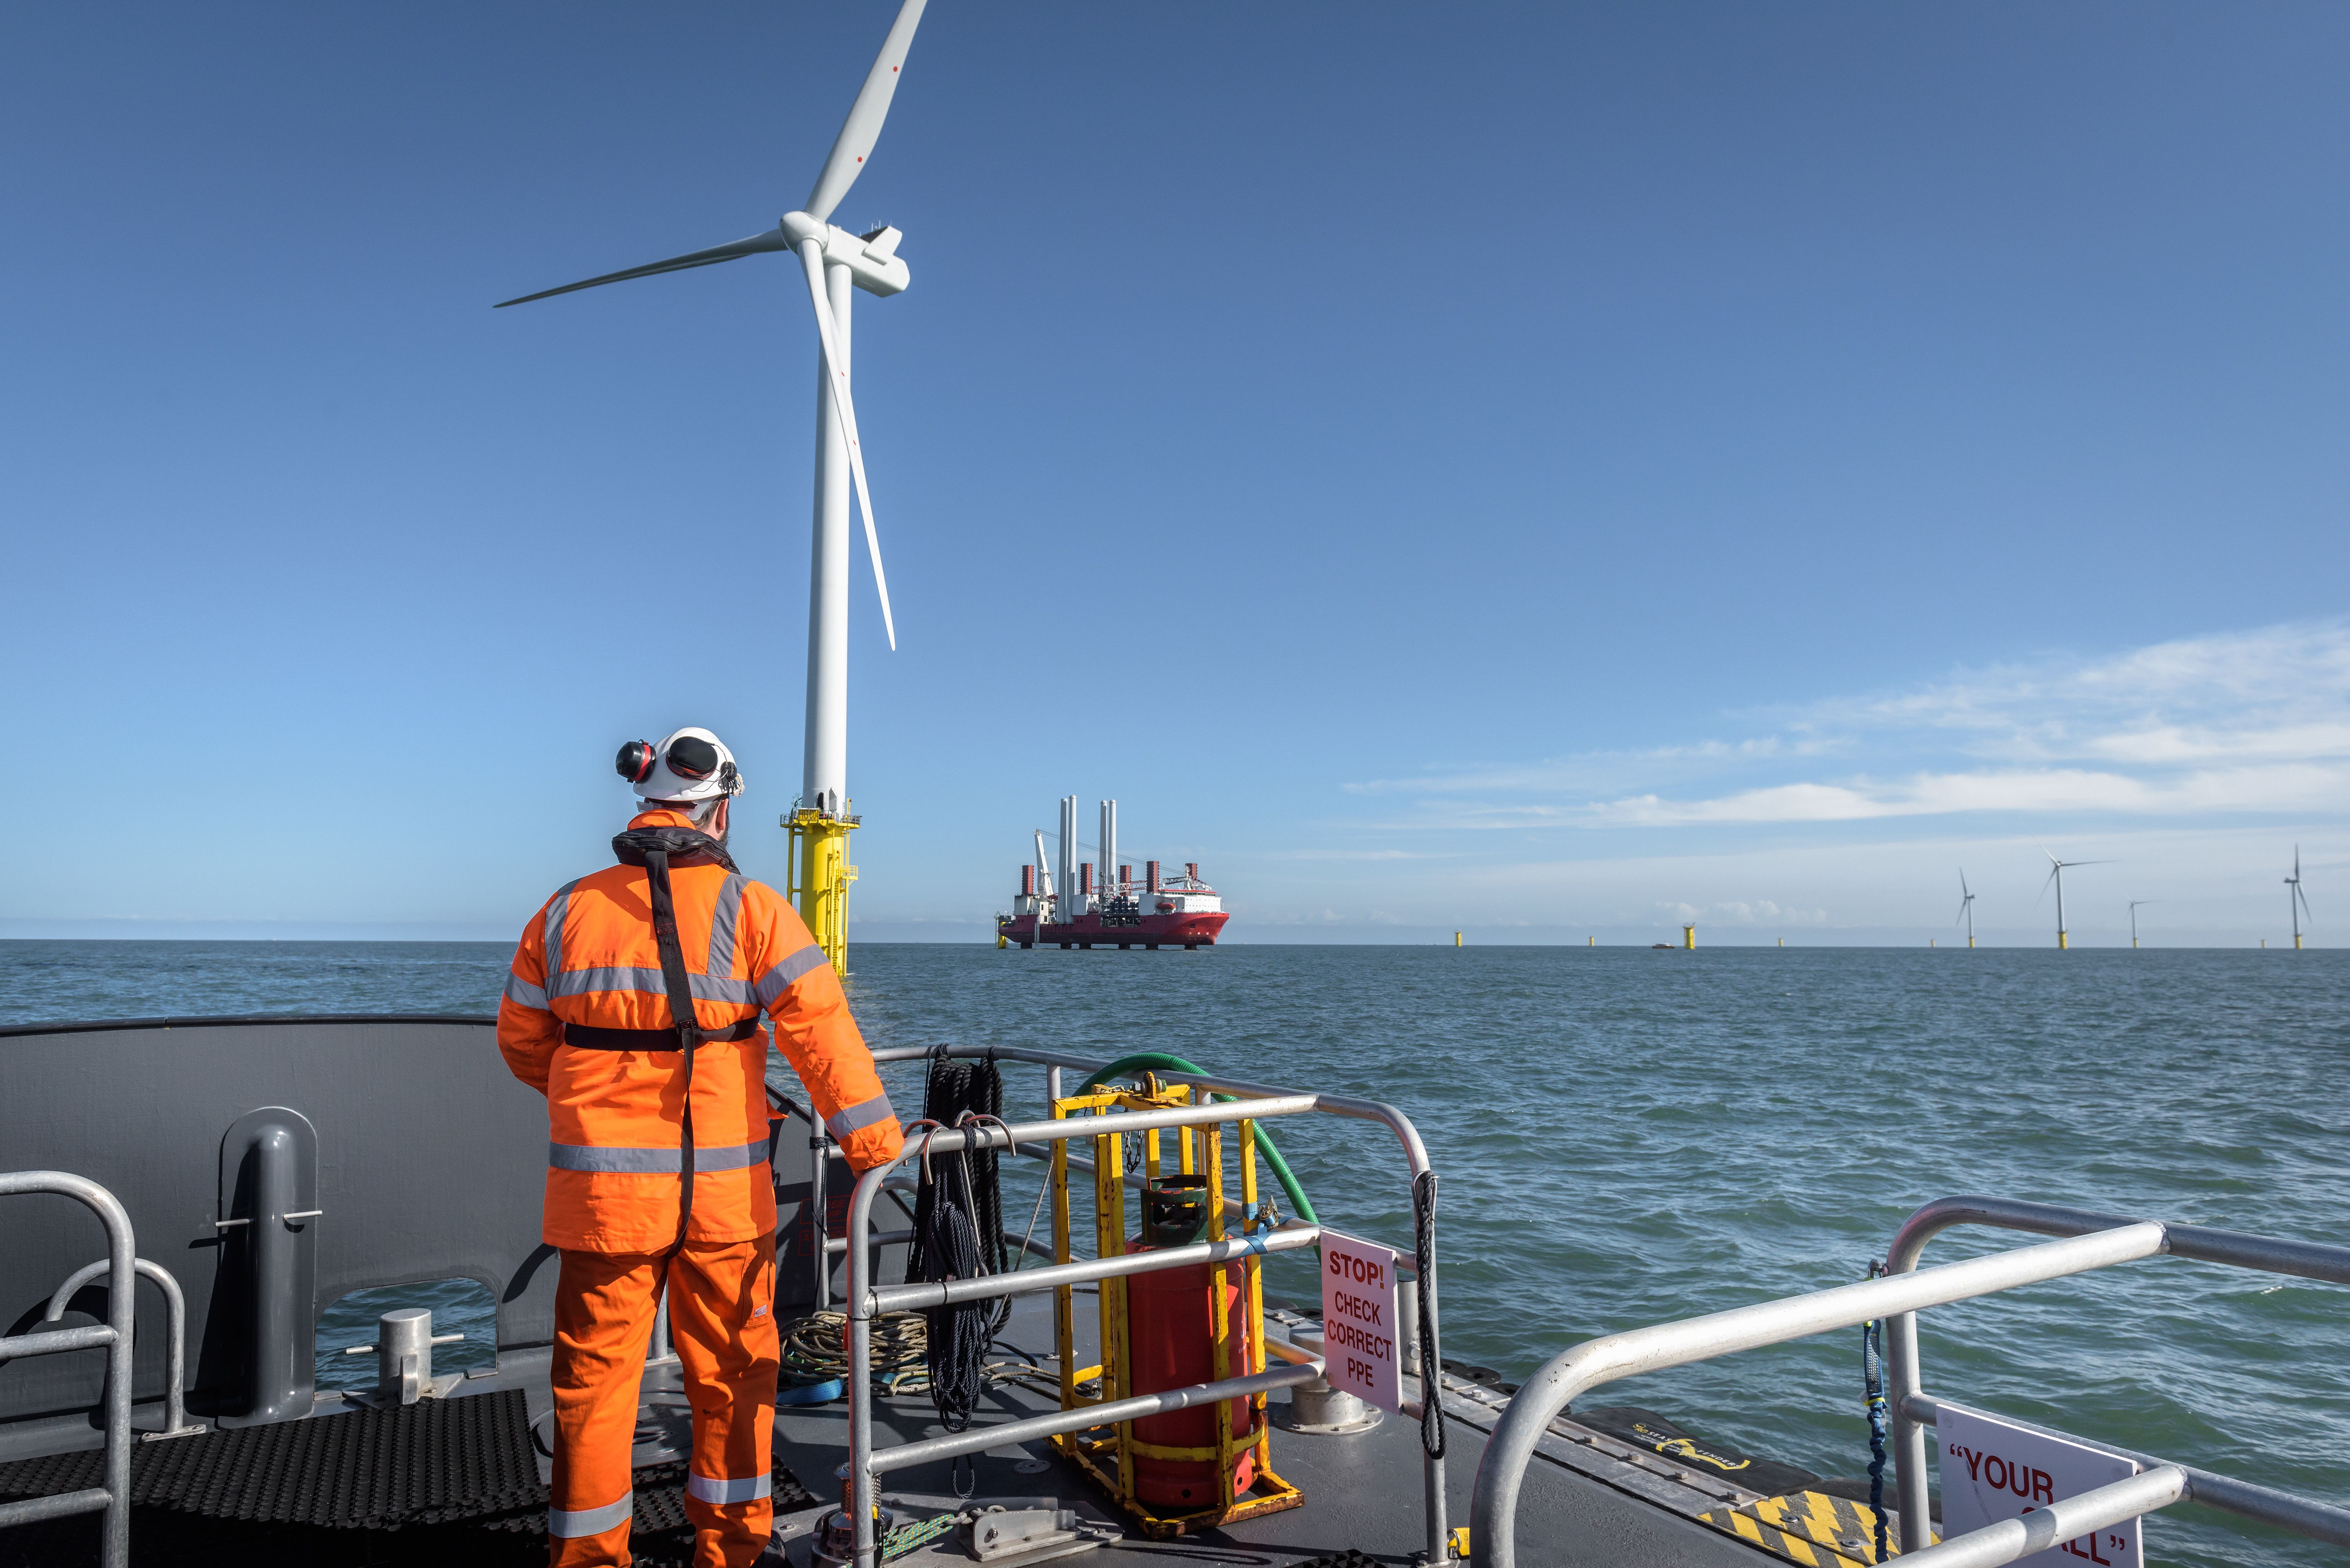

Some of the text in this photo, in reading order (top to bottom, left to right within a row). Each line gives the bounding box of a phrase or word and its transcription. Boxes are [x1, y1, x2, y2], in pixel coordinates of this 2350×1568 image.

[799, 810, 818, 819] HG C04
[1330, 1251, 1384, 1289] STOP!
[1335, 1291, 1382, 1326] CHECK
[1328, 1319, 1392, 1361] CORRECT
[1348, 1357, 1373, 1388] PPE
[1950, 1443, 2053, 1505] “YOUR
